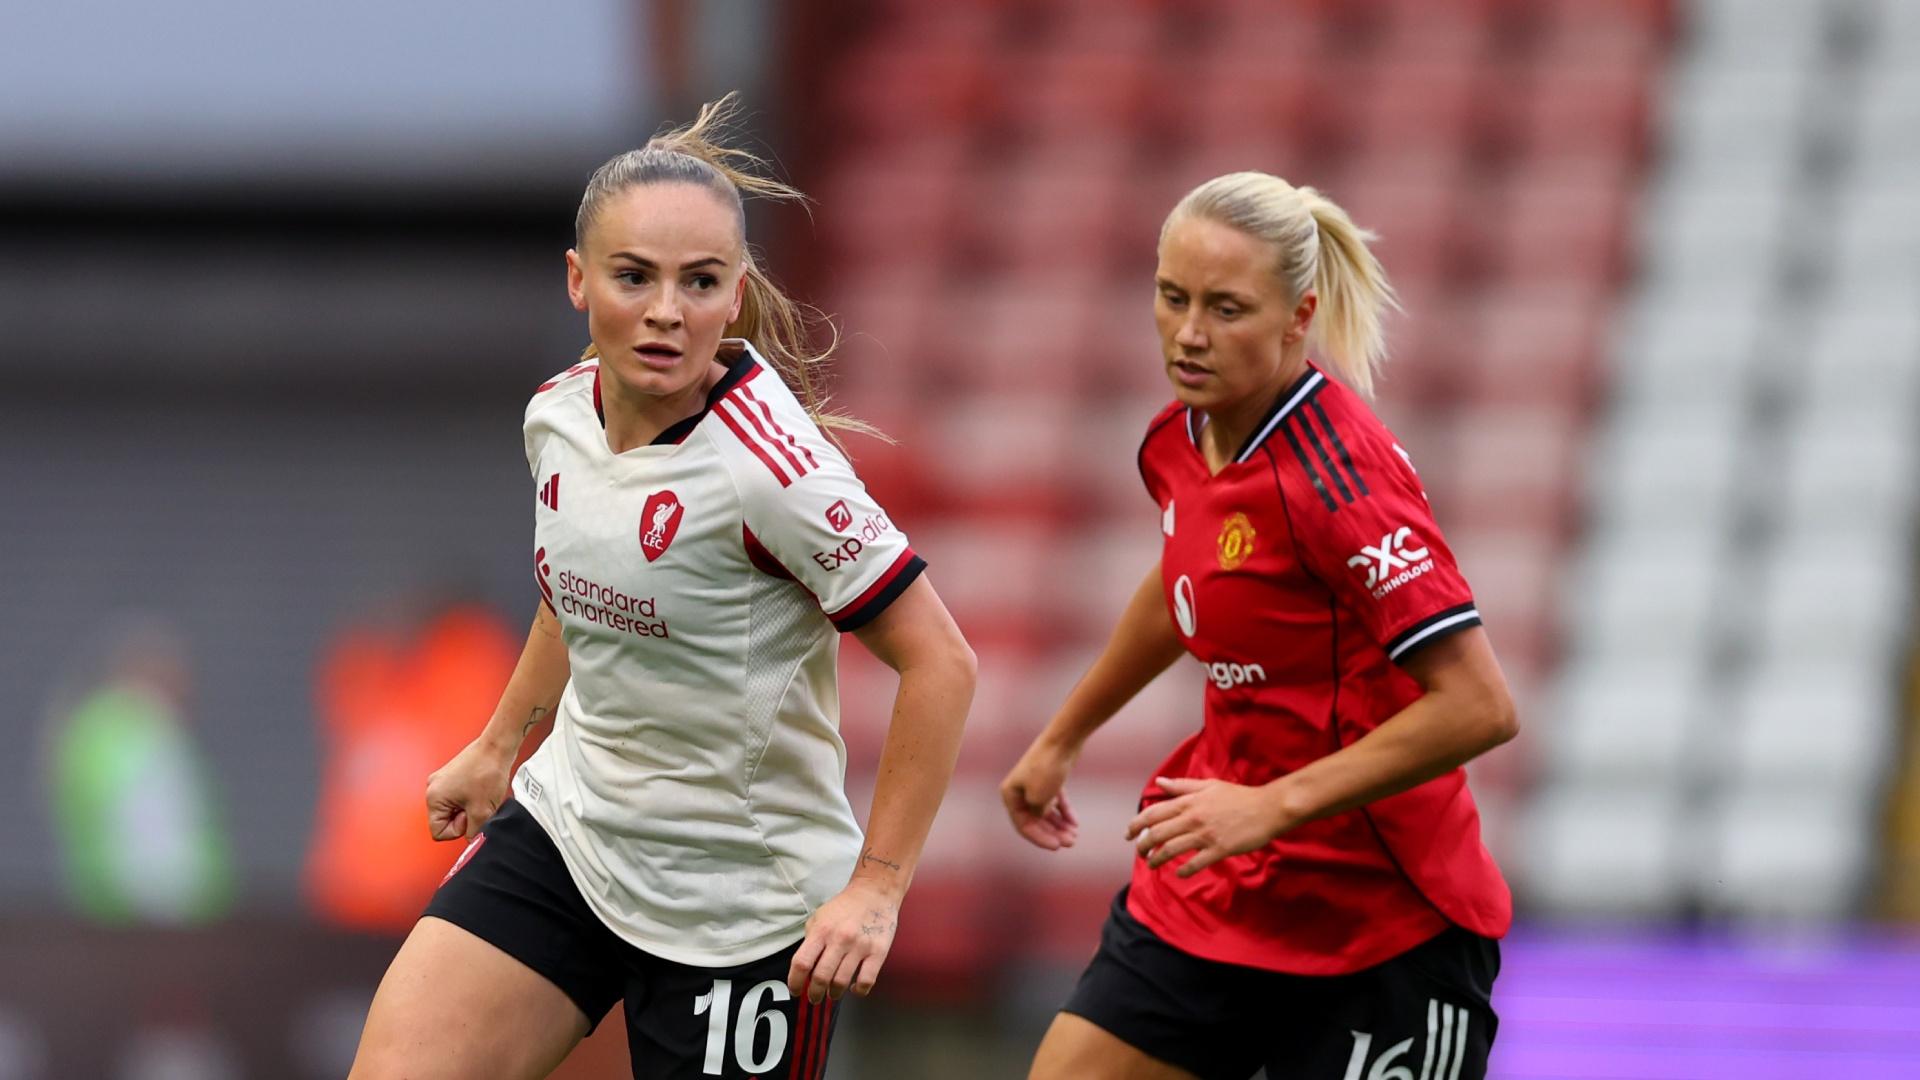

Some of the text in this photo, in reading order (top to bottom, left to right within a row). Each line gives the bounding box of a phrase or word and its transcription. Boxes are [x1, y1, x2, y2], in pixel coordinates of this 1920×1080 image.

[812, 513, 889, 572] Expdia
[559, 570, 655, 618] standard
[561, 594, 669, 638] chartered
[694, 979, 791, 1076] 16
